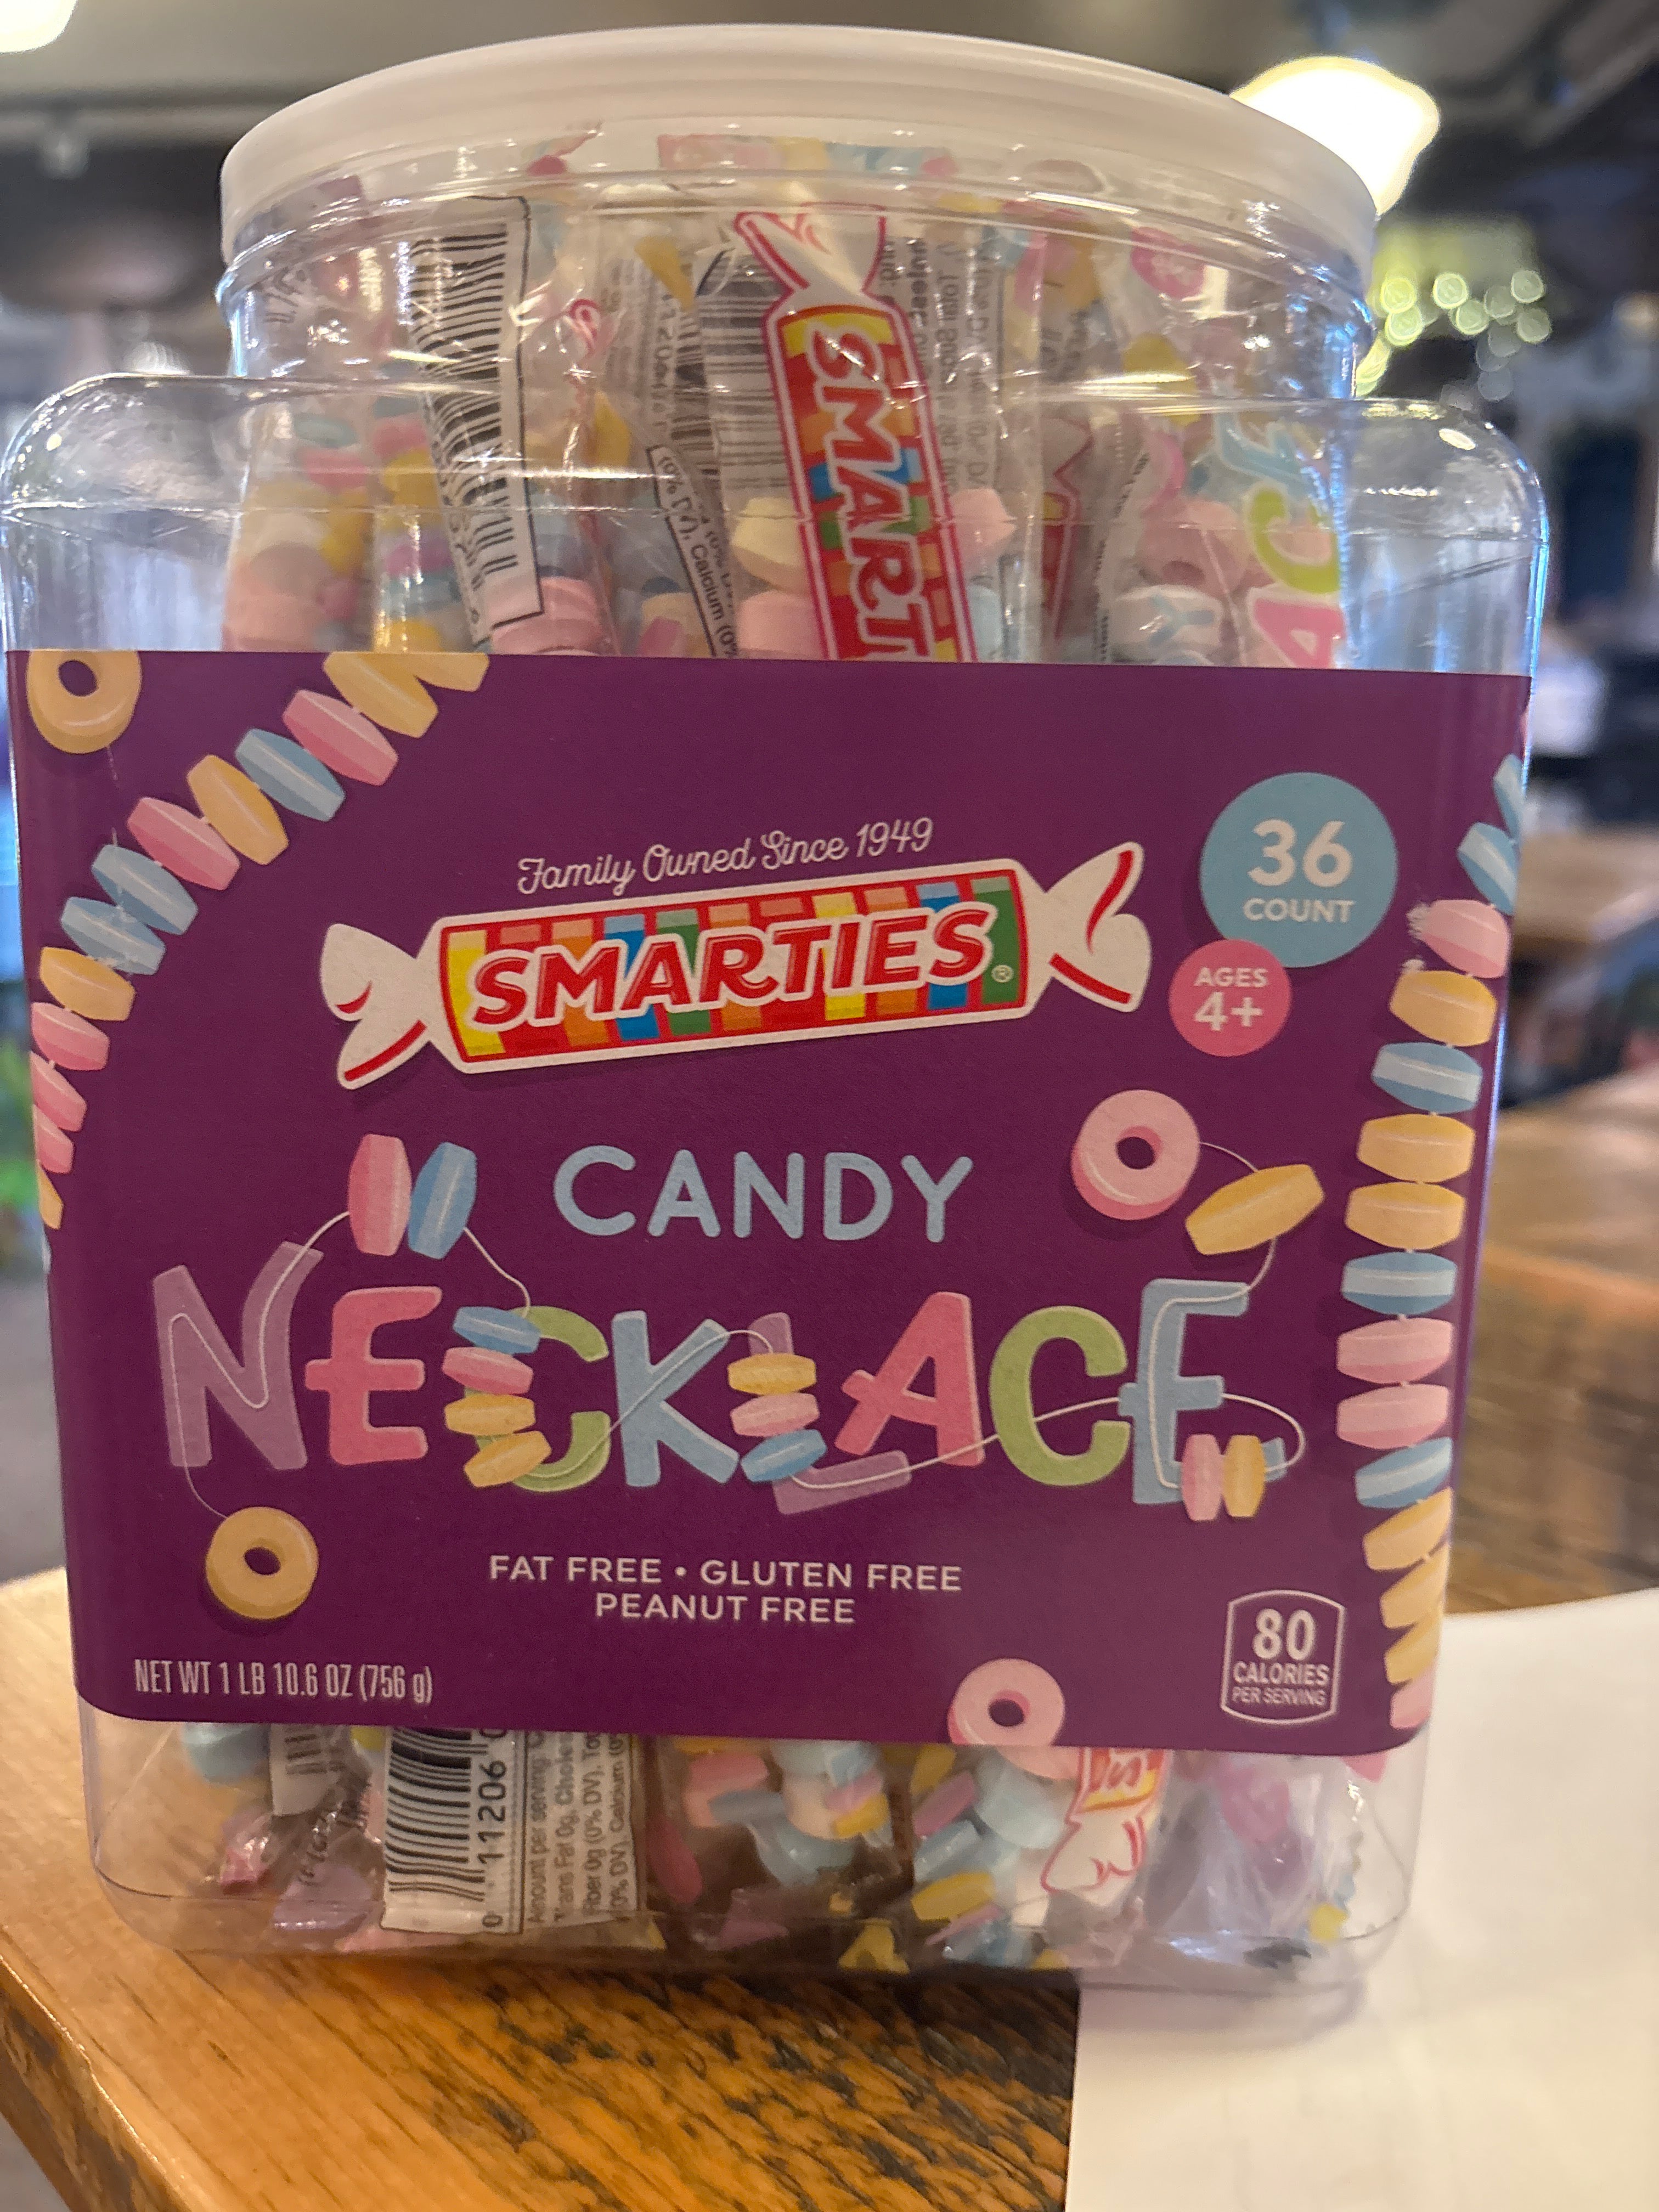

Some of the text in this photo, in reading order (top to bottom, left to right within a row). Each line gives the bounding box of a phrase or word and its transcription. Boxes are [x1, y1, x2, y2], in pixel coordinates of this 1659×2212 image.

[690, 543, 725, 621] Calcium
[517, 817, 933, 896] Family Owned Since 1949
[1247, 818, 1353, 888] 36
[1243, 898, 1357, 923] COUNT
[1193, 966, 1269, 988] AGES
[1193, 991, 1263, 1032] 4+
[552, 1144, 973, 1243] CANDY
[153, 1240, 1288, 1516] NECKLACE
[488, 1554, 963, 1592] FAT FREE GLUTEN FREE
[595, 1592, 855, 1623] PEANUT FREE
[1252, 1607, 1316, 1661] 80
[133, 1658, 433, 1705] NET WT 1 LB 10.6 OZ (756 g)
[1231, 1686, 1327, 1706] PER SERVING
[1233, 1660, 1330, 1686] CALORIES
[477, 1760, 507, 1865] 11206
